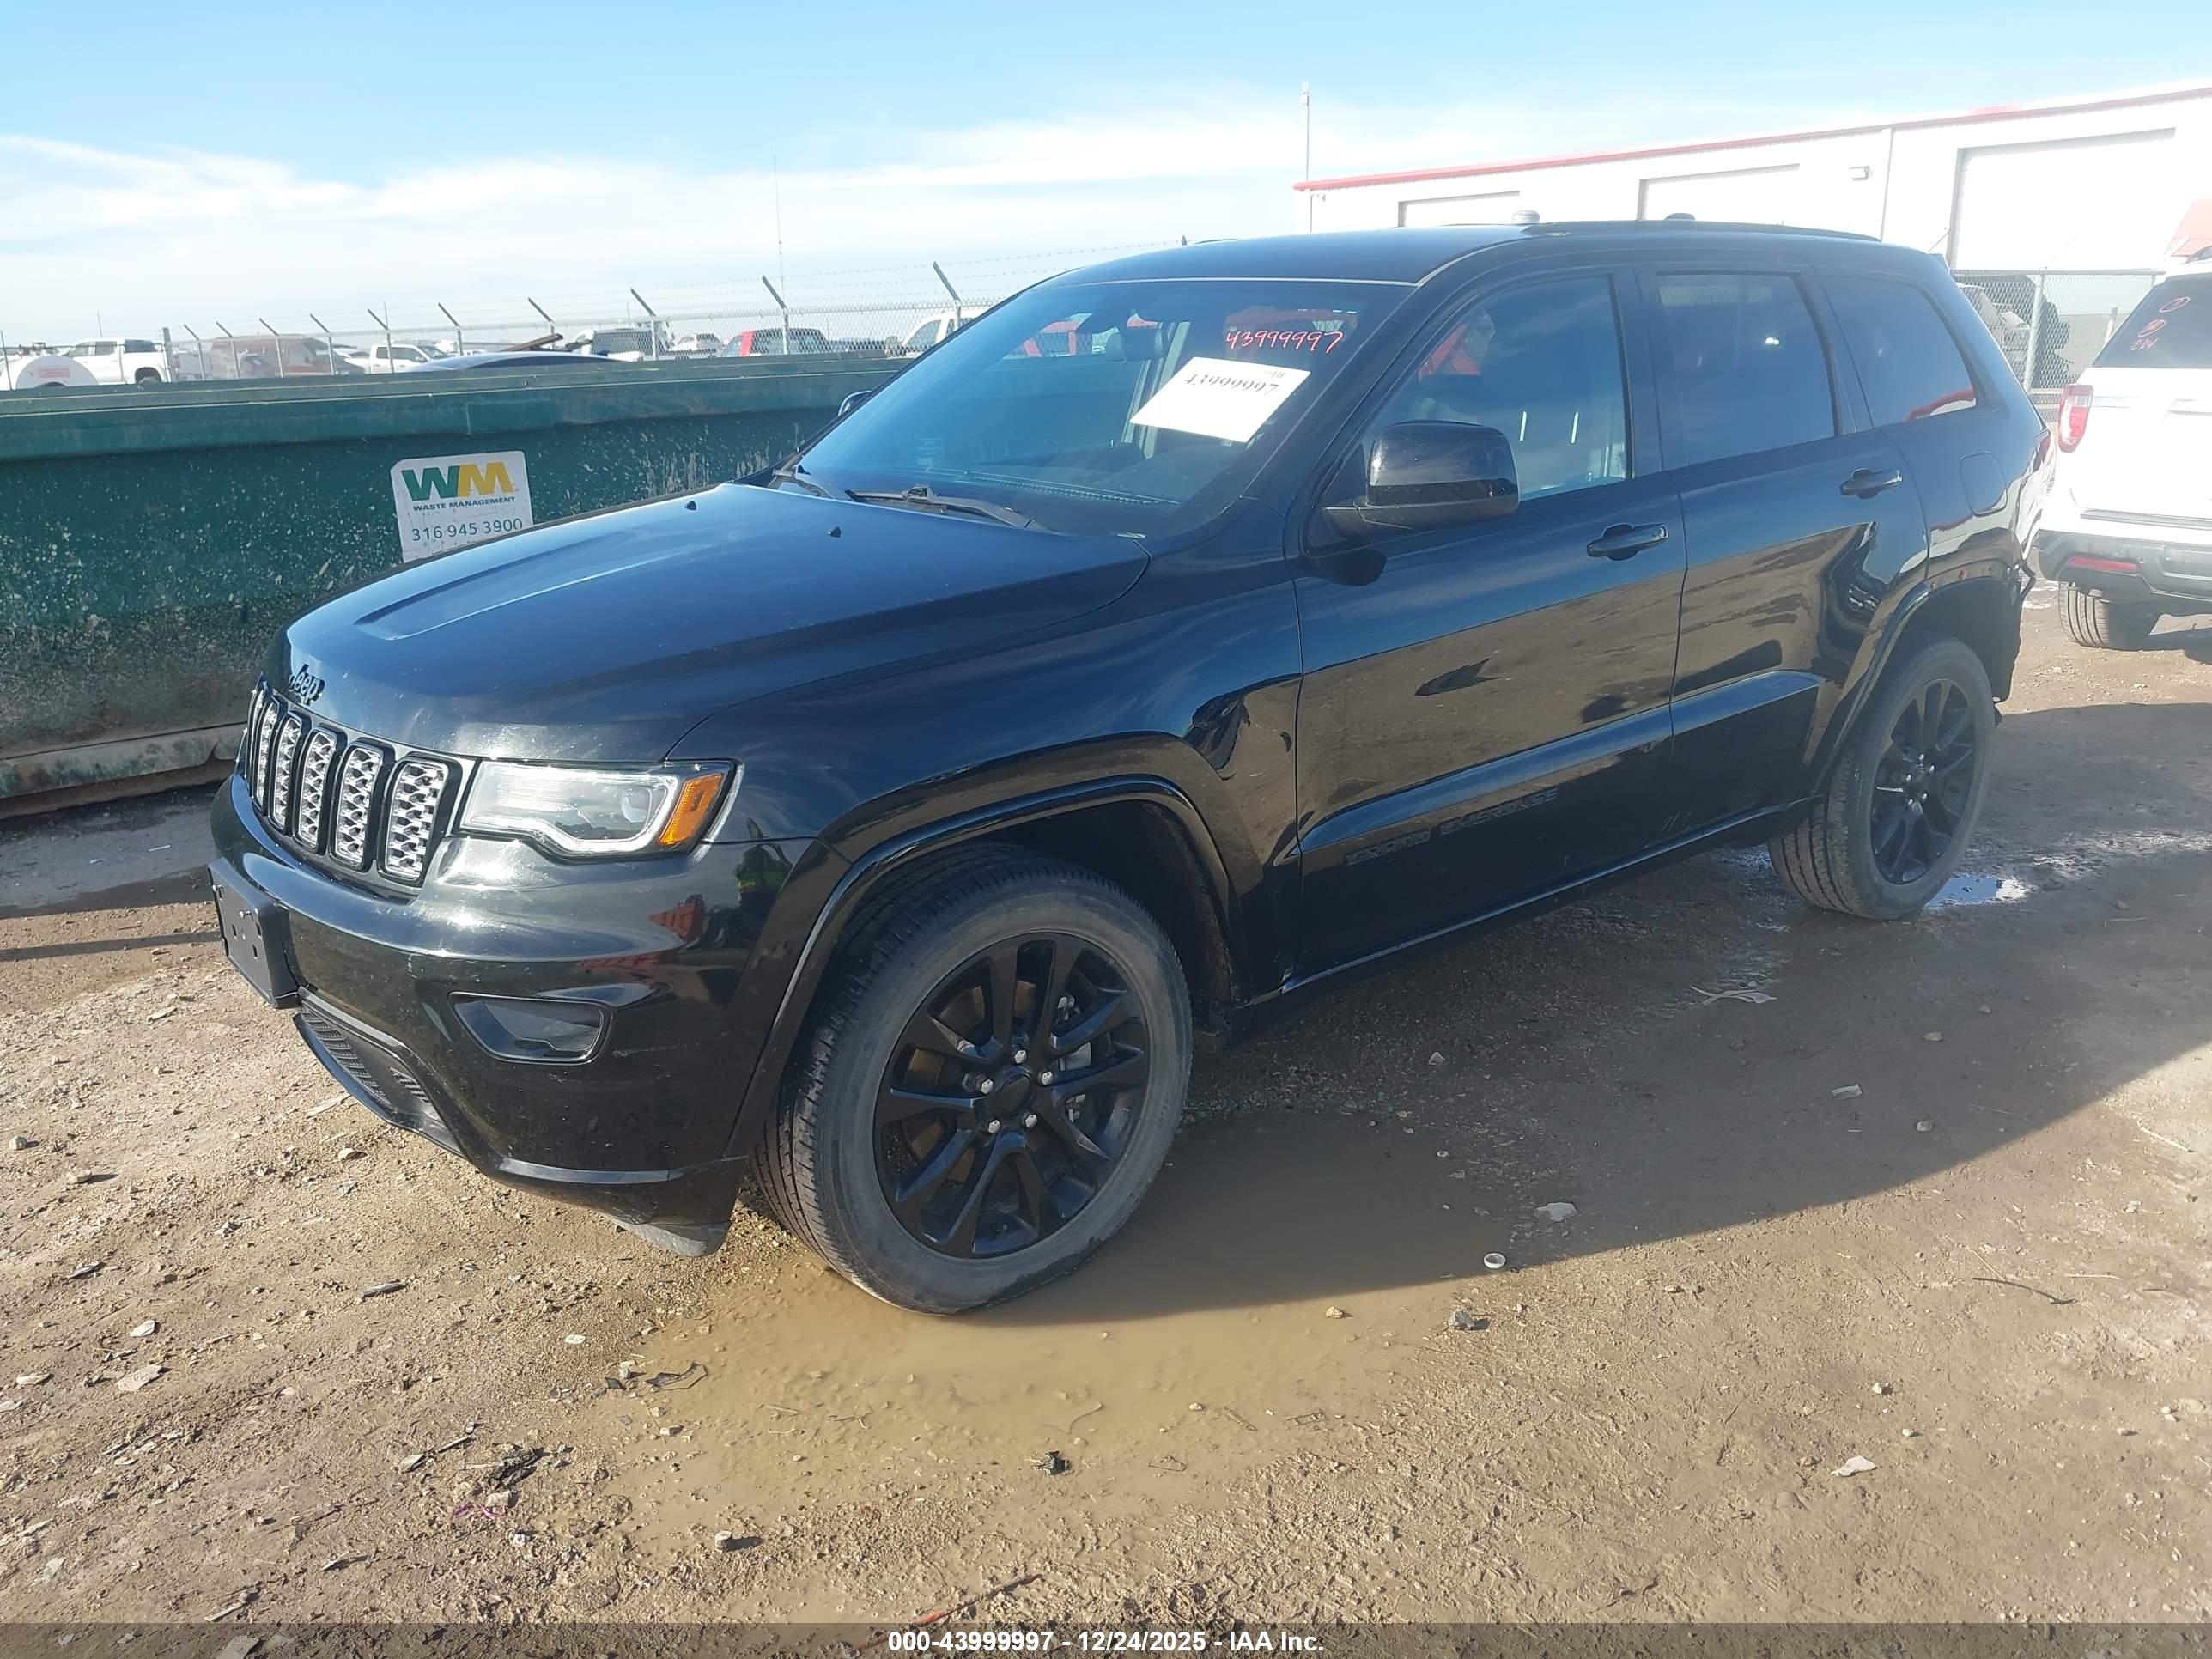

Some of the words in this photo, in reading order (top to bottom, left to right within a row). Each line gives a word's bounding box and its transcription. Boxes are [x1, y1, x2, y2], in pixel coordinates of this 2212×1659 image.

[1226, 330, 1344, 354] 43999997
[401, 461, 514, 501] WM
[413, 502, 447, 511] WASTE
[449, 496, 515, 508] MANAGEMENT
[412, 526, 443, 541] 316
[447, 522, 477, 538] 945
[483, 518, 523, 534] 3900
[289, 664, 325, 706] Jeep
